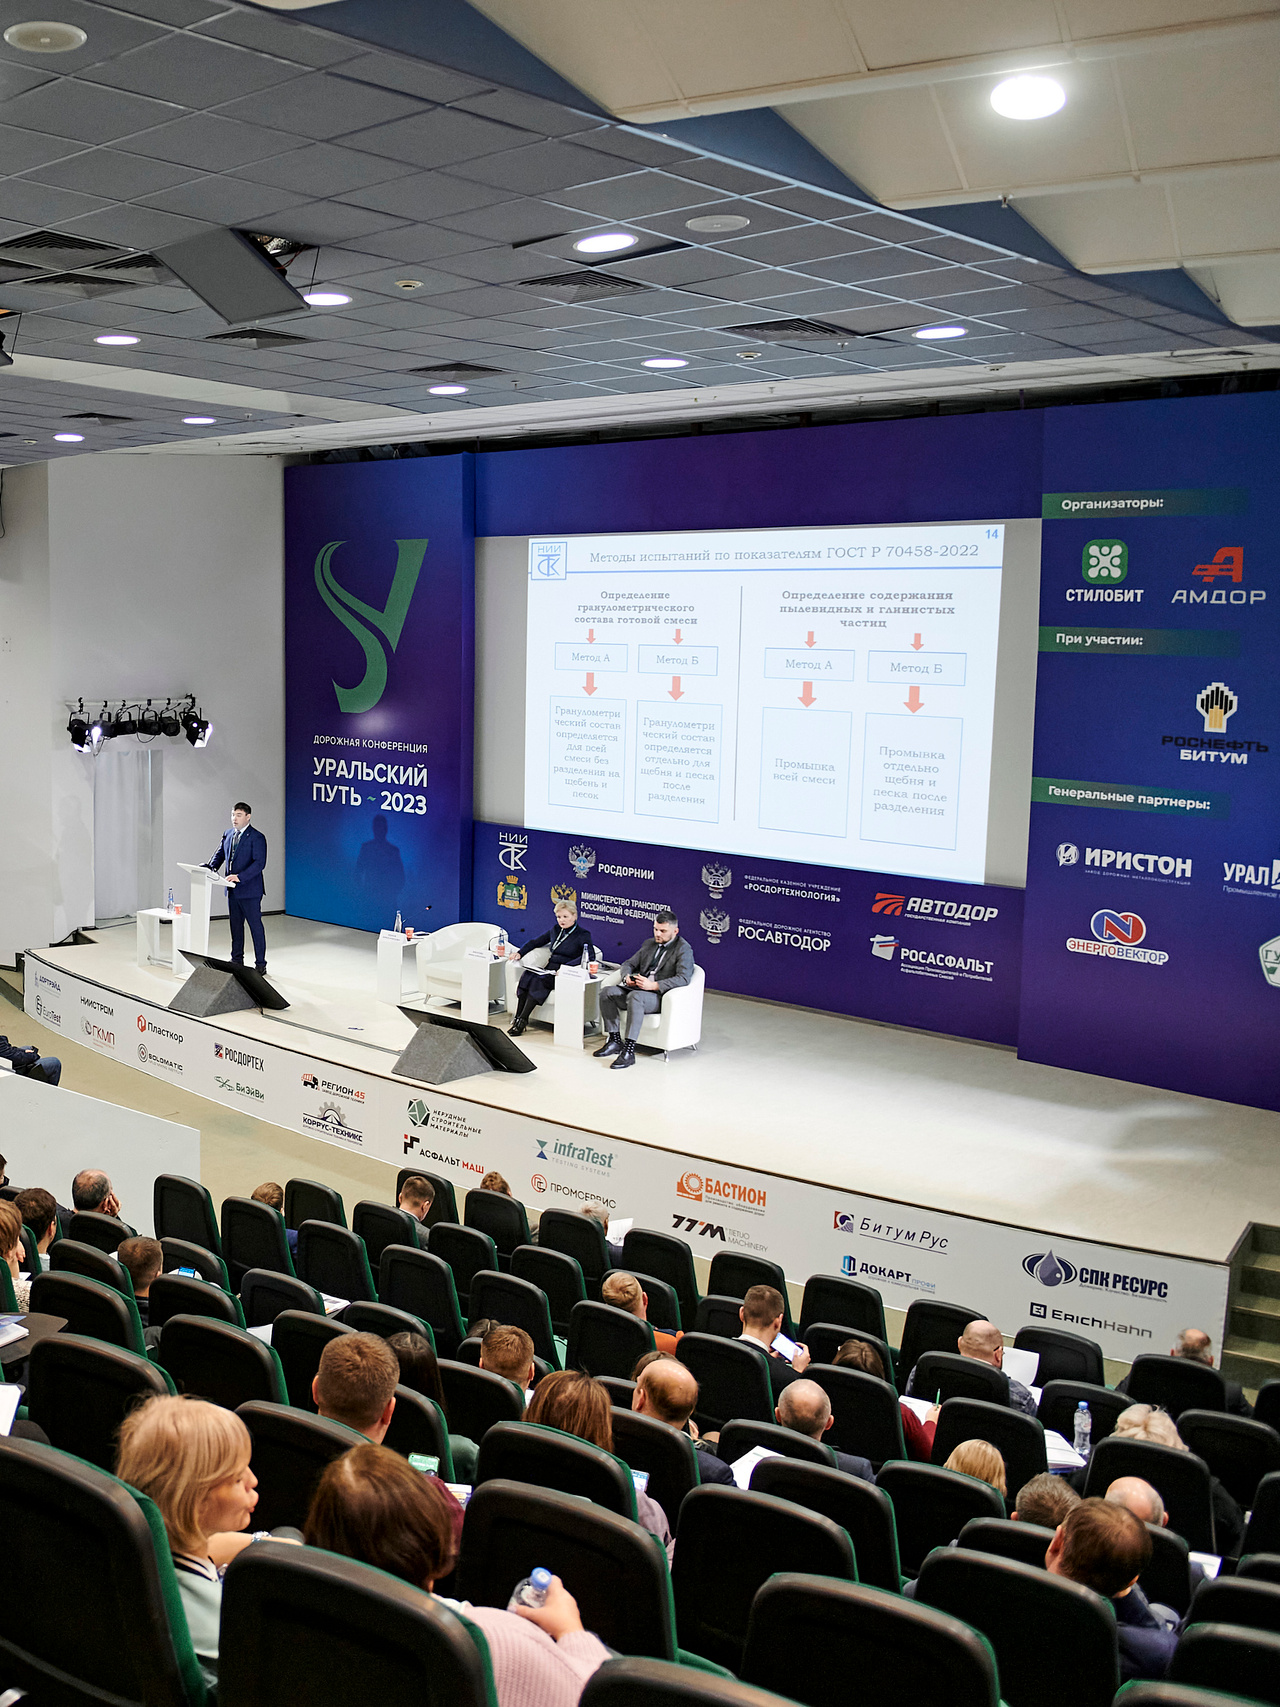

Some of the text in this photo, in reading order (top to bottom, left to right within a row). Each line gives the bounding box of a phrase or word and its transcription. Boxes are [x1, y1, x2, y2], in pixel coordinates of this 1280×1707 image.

[1061, 498, 1164, 511] Организаторы:
[985, 528, 999, 540] 14
[590, 552, 636, 563] Методы
[639, 550, 710, 562] испытаний
[715, 552, 730, 561] по
[735, 549, 821, 560] показателям
[827, 546, 867, 559] ГОСТ
[886, 544, 979, 558] 70458-2022
[600, 591, 671, 601] Определение
[782, 590, 953, 601] Определение содержания
[1065, 589, 1144, 602] СТИЛОБИТ
[1171, 589, 1267, 604] АМДОР
[577, 603, 695, 613] гранулометрического
[779, 605, 955, 615] пылевидных и глинистых
[574, 615, 698, 625] состава готовой смеси
[840, 618, 887, 628] частиц
[1055, 633, 1144, 647] При участии:
[571, 652, 601, 663] Метод
[656, 655, 699, 665] Метод Б
[785, 659, 821, 670] Метод
[890, 662, 943, 674] Метод Б
[555, 705, 621, 719] Гранулометри
[554, 717, 587, 727] ческий
[643, 717, 715, 731] Гранулометри
[556, 731, 618, 742] определяется
[642, 730, 677, 740] ческий
[313, 735, 428, 753] ДОРОЖНАЯ КОНФЕРЕНЦИЯ
[566, 743, 583, 752] для
[644, 743, 712, 755] определяется
[1161, 735, 1269, 752] РОСНЕФТЬ
[564, 755, 609, 765] смеси без
[879, 746, 946, 760] Промывка
[1179, 749, 1248, 765] БИТУМ
[644, 755, 711, 768] отдельно для
[774, 758, 835, 772] Промывка
[883, 761, 940, 774] отдельно
[313, 757, 428, 788] УРАЛЬСКИЙ
[553, 766, 621, 778] разделения на
[640, 766, 673, 777] щебня
[685, 771, 715, 781] песка
[773, 772, 836, 785] всей смеси
[564, 778, 599, 788] щебень
[663, 781, 691, 791] после
[884, 775, 936, 787] щебня и
[312, 782, 427, 815] ПУТЬ 2023
[572, 790, 599, 800] песок
[648, 792, 706, 805] разделения
[873, 788, 948, 802] песка после
[1048, 786, 1211, 811] Генеральные партнеры:
[873, 802, 945, 816] разделения
[499, 832, 528, 844] НИИ
[1084, 847, 1193, 878] ИРИСТОН
[598, 863, 655, 880] РОСДОРНИИ
[1223, 862, 1270, 886] УРАЛ
[744, 882, 841, 903] «РОСДОРТЕХНОЛОГИЯ»
[580, 901, 623, 915] РОССИЙСКОЙ
[581, 891, 672, 912] МИНИСТЕРСТВО ТРАНСПОРТА
[906, 897, 999, 921] АВТОДОР
[738, 925, 831, 951] РОСАВТОДОР
[1067, 939, 1167, 964] ЭНЕРГОВЕКТОР
[900, 947, 994, 974] РОСАСФАЛЬТ
[147, 1021, 184, 1044] Пласткор
[224, 1047, 265, 1072] РОСДОРТЕХ
[235, 1082, 265, 1100] БиЭйВи
[432, 1109, 466, 1123] НЕРУДНЫЕ
[430, 1123, 469, 1138] МАТЕРИАЛЫ
[431, 1116, 482, 1134] СТРОИТЕЛЬНЫЕ
[553, 1138, 614, 1168] infraTest
[419, 1148, 484, 1174] АСФАЛЬТ МАШ
[552, 1157, 611, 1178] TESTING SYSTEMS
[705, 1177, 767, 1207] БАСТИОН
[727, 1236, 769, 1252] MACHINERY
[859, 1262, 912, 1283] ДОКАРТ
[1079, 1267, 1168, 1299] СПК РЕСУРС
